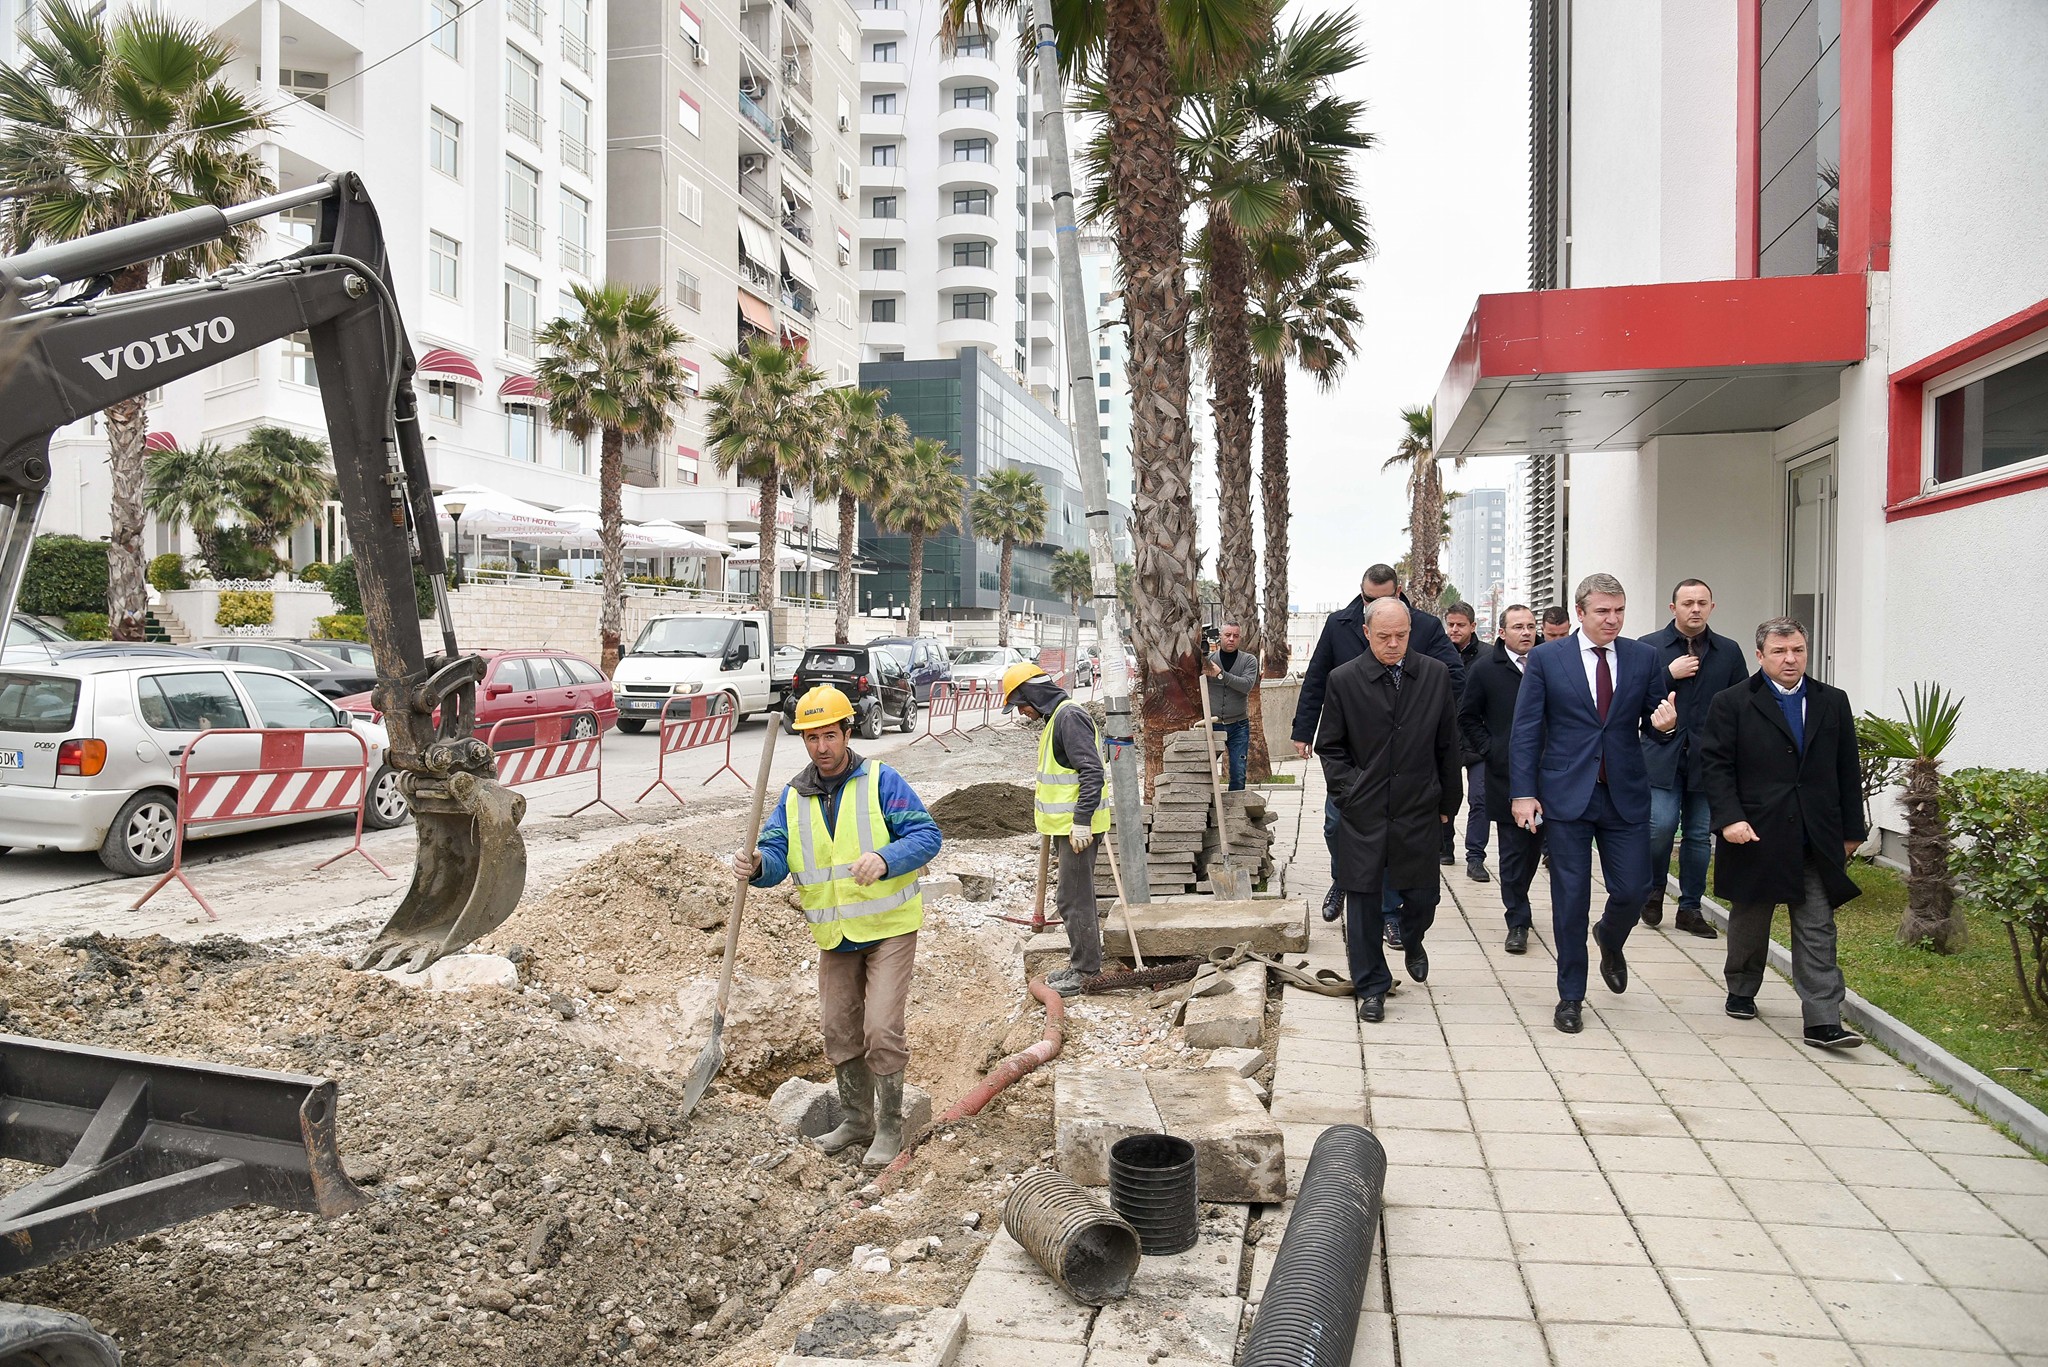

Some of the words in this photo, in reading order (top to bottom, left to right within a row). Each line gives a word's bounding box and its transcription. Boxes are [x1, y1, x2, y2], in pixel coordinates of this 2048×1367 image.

[81, 316, 235, 380] VOLVO
[442, 373, 474, 385] HOTEL
[532, 518, 557, 527] HOTEL
